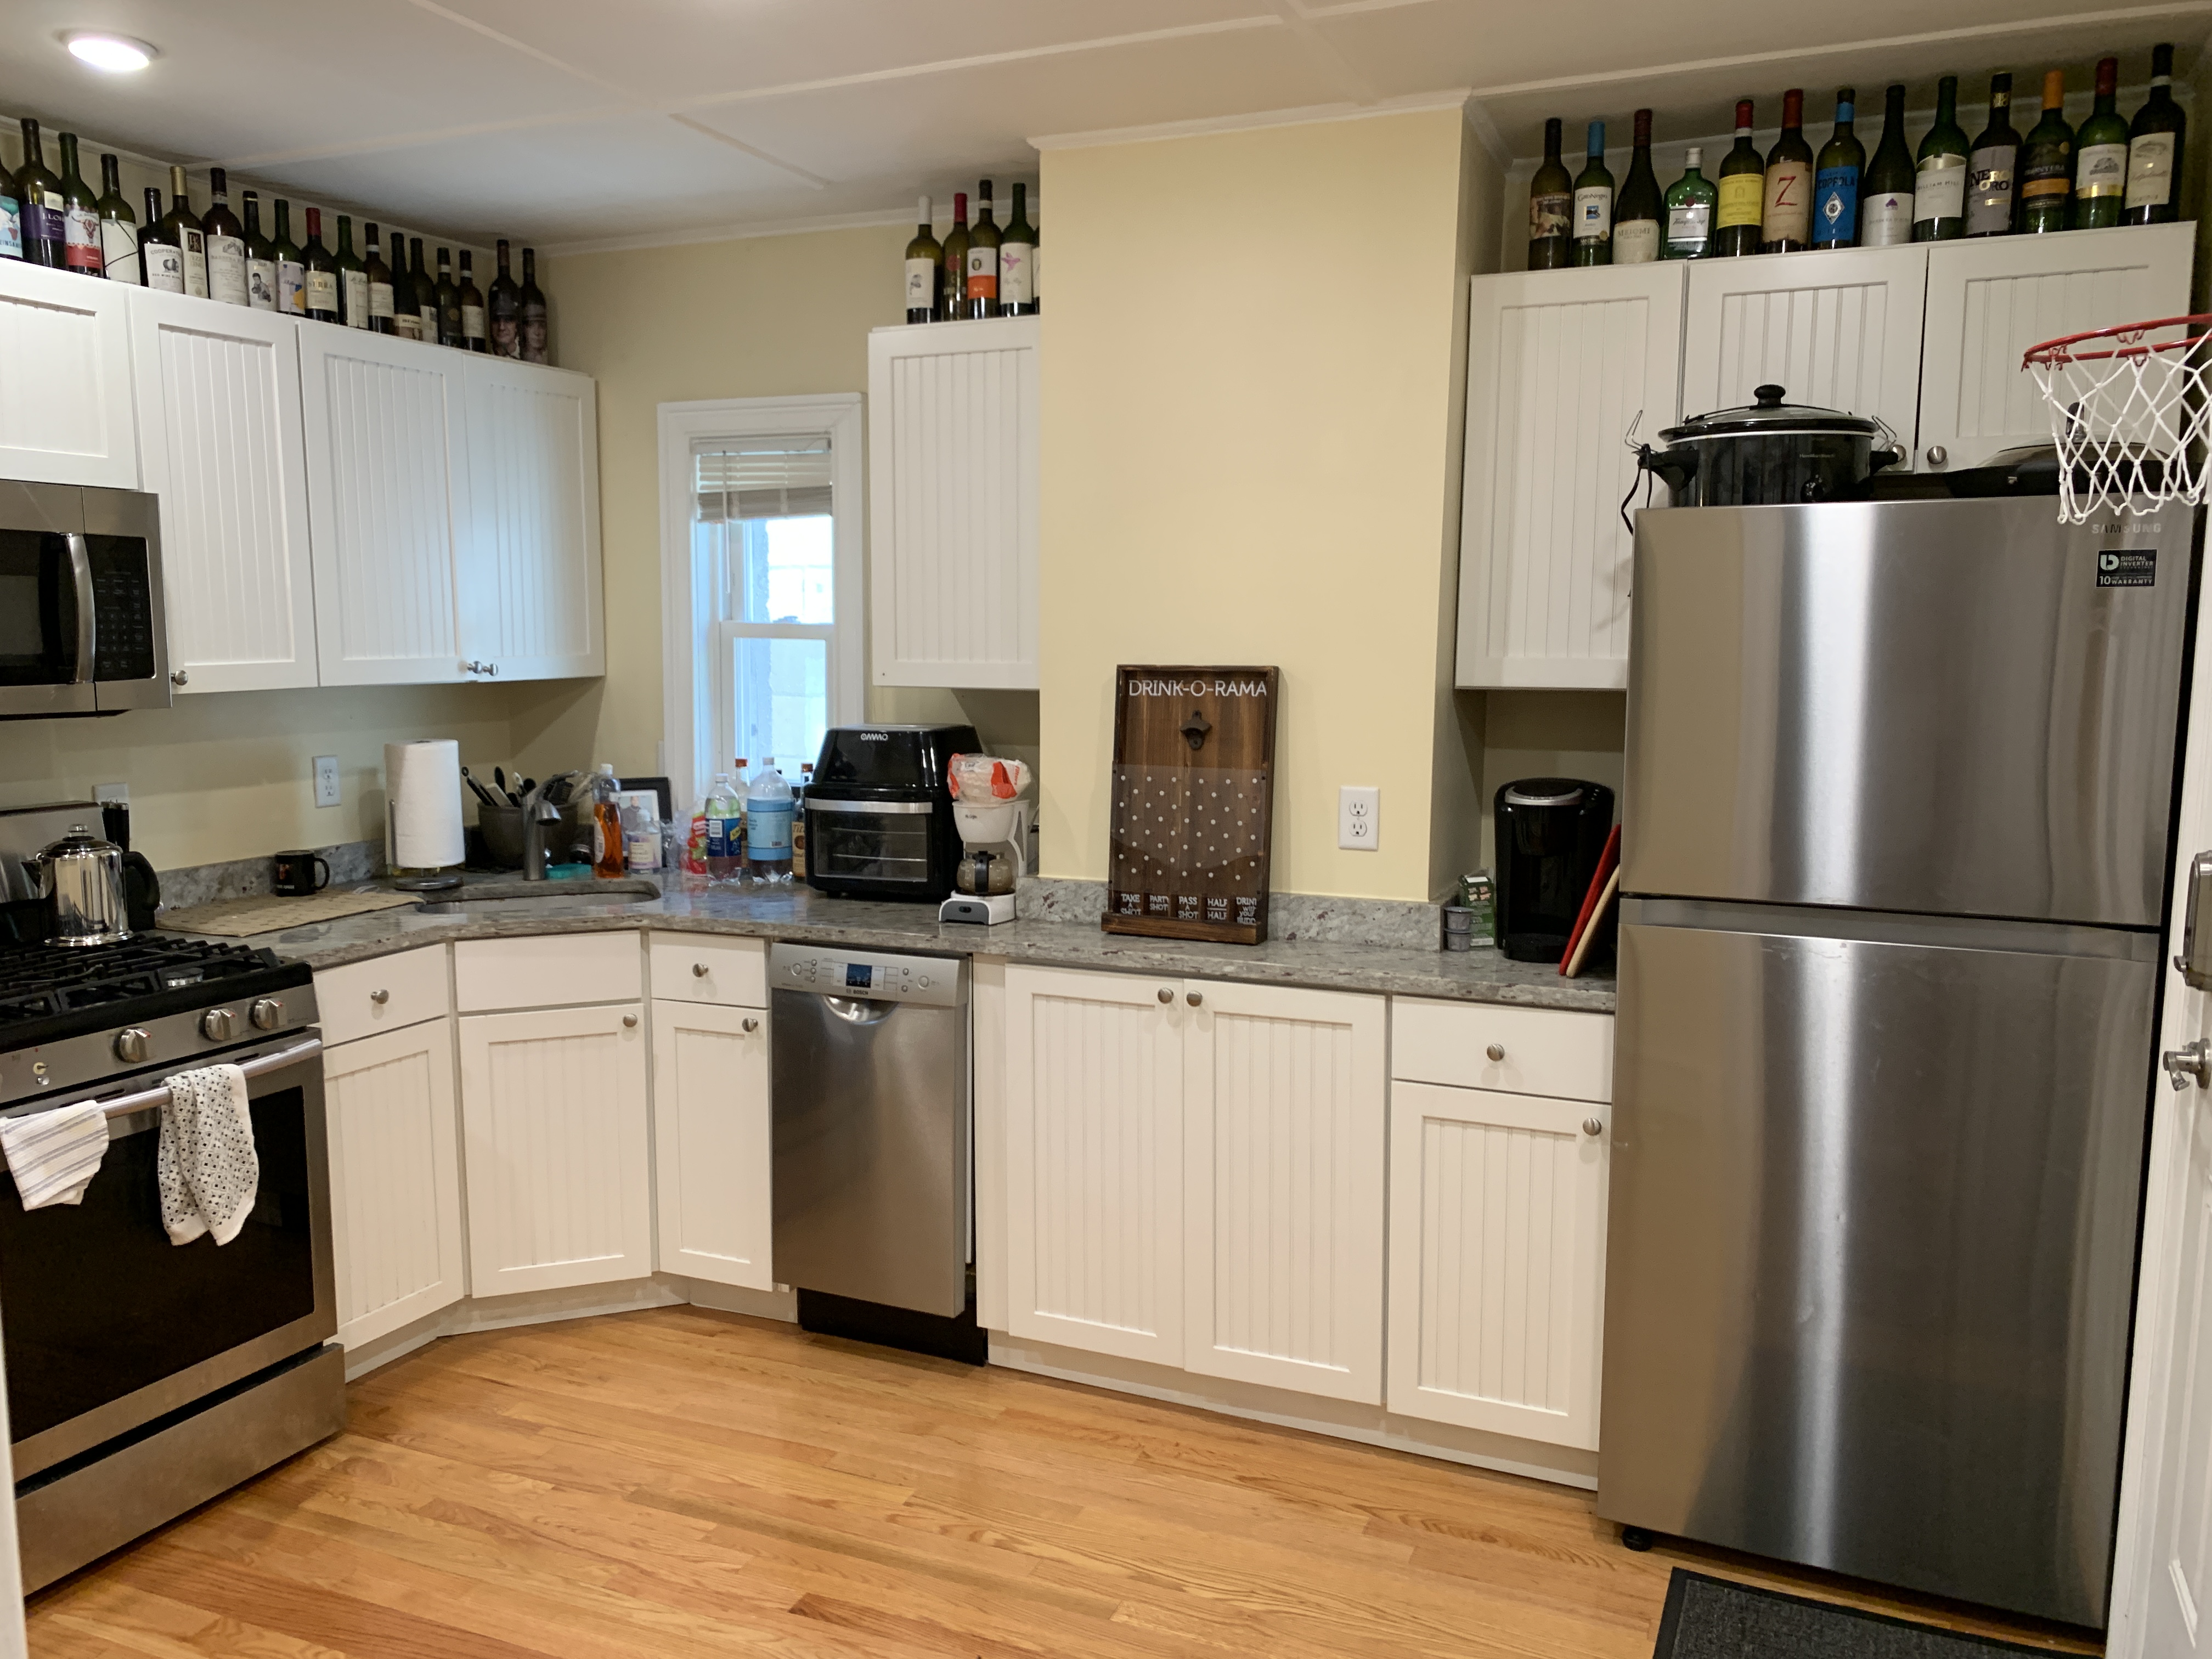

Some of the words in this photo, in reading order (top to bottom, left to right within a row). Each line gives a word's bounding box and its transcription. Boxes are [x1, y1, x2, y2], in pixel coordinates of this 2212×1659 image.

[1818, 176, 1855, 189] COPPOLA
[1970, 169, 2011, 187] NERO
[1979, 179, 2009, 191] ORO
[1774, 176, 1798, 208] Z
[2091, 523, 2162, 534] SAMSUNG
[2100, 575, 2111, 585] 10
[1128, 680, 1267, 697] DRINK-O-RAMA
[1121, 894, 1140, 902] TAKE
[1178, 896, 1197, 905] PASS
[1207, 898, 1227, 907] HALF
[1178, 911, 1199, 919] SHOT
[1207, 911, 1227, 920] HALF
